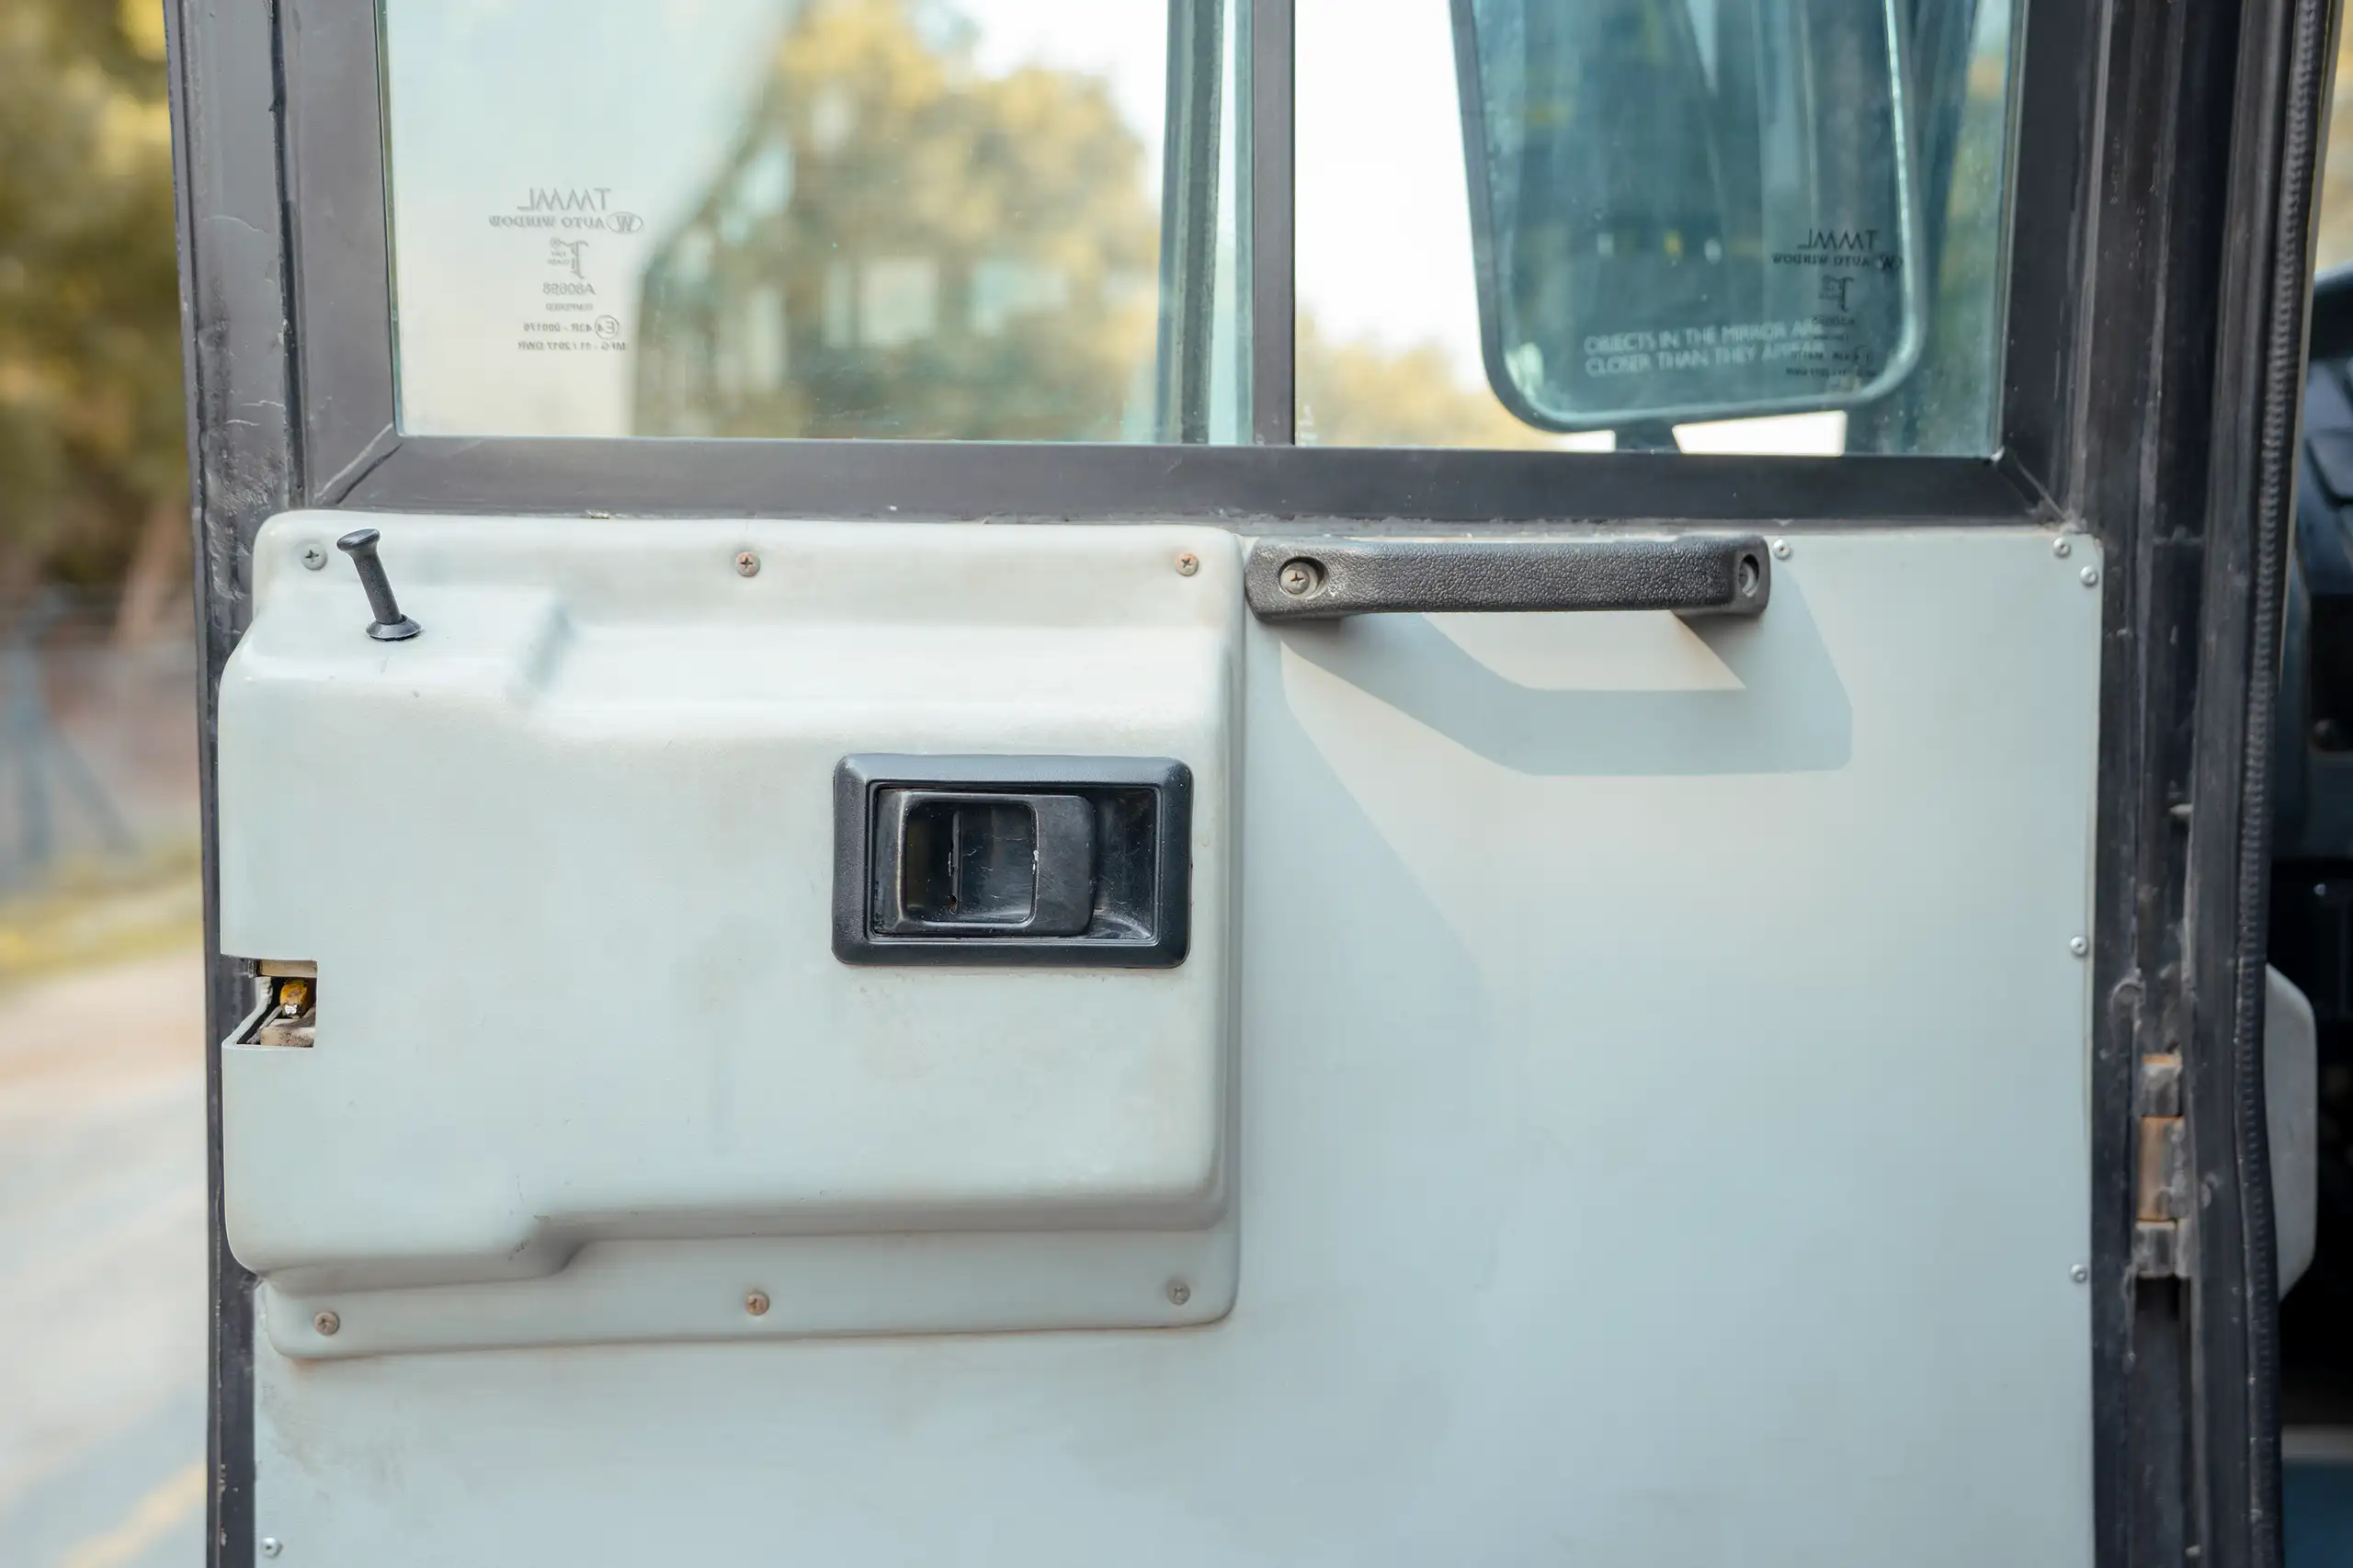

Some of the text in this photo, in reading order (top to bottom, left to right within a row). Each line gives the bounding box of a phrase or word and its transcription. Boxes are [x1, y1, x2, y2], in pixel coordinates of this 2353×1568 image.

[1658, 329, 1680, 348] IN
[1684, 324, 1718, 346] THE
[1722, 321, 1787, 345] MIRROR
[1656, 348, 1710, 371] THAN
[1714, 341, 1755, 366] THEY
